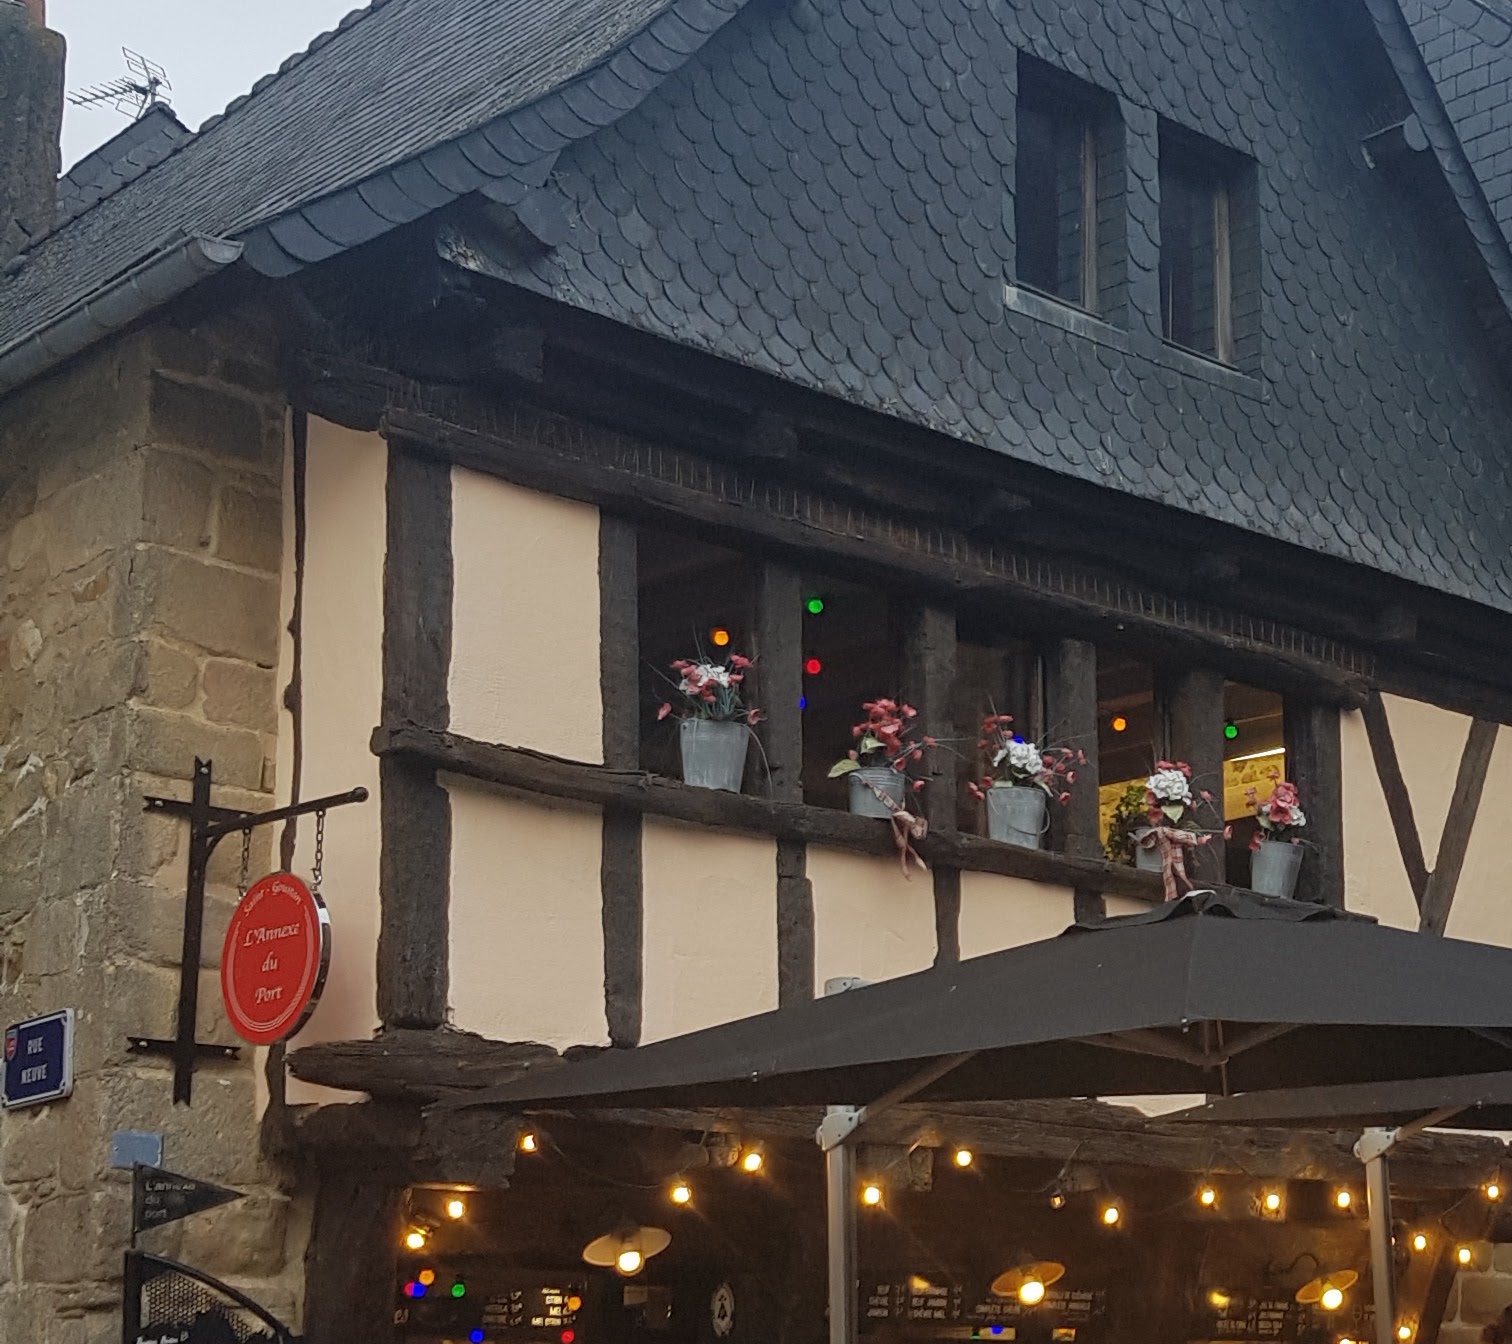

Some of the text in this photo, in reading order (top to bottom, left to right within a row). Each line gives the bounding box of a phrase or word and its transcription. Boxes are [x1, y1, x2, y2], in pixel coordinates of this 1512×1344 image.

[243, 922, 300, 948] L'Annexe
[261, 951, 279, 973] du
[255, 985, 284, 1005] Port
[27, 1037, 43, 1055] RUE
[21, 1063, 48, 1085] NEUVE
